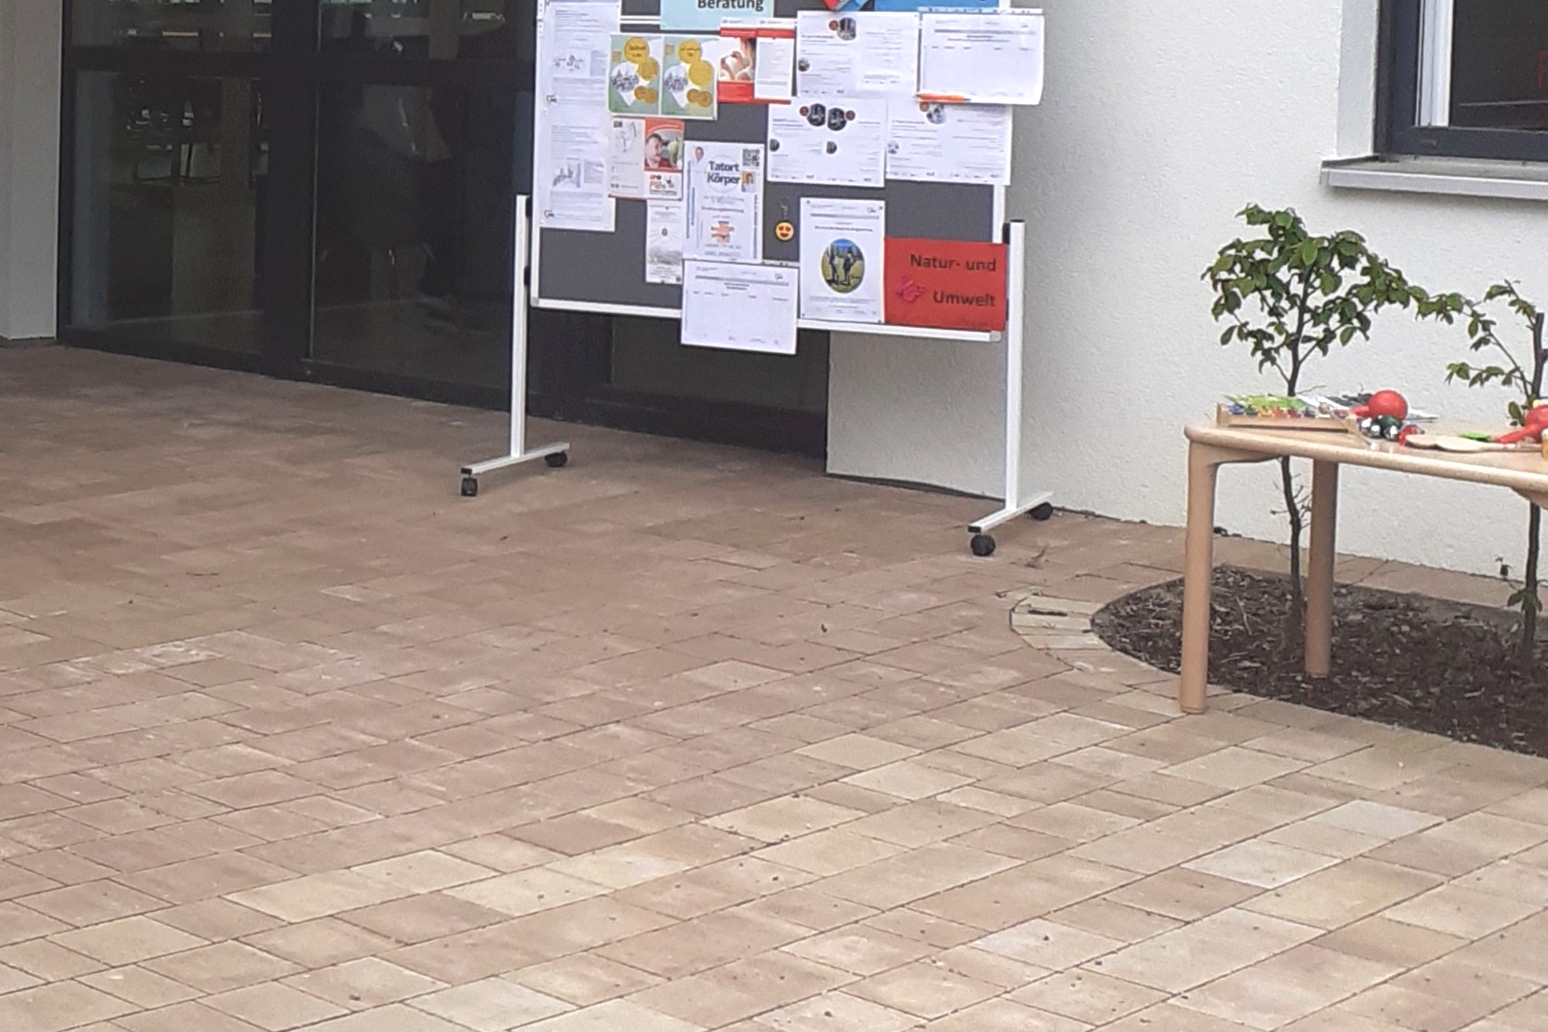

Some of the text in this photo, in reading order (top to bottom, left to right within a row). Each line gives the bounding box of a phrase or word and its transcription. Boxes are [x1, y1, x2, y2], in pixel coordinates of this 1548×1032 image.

[708, 160, 740, 172] Tatort
[707, 172, 741, 186] Körper
[910, 253, 997, 272] Natur- und
[932, 290, 996, 307] Umwelt
